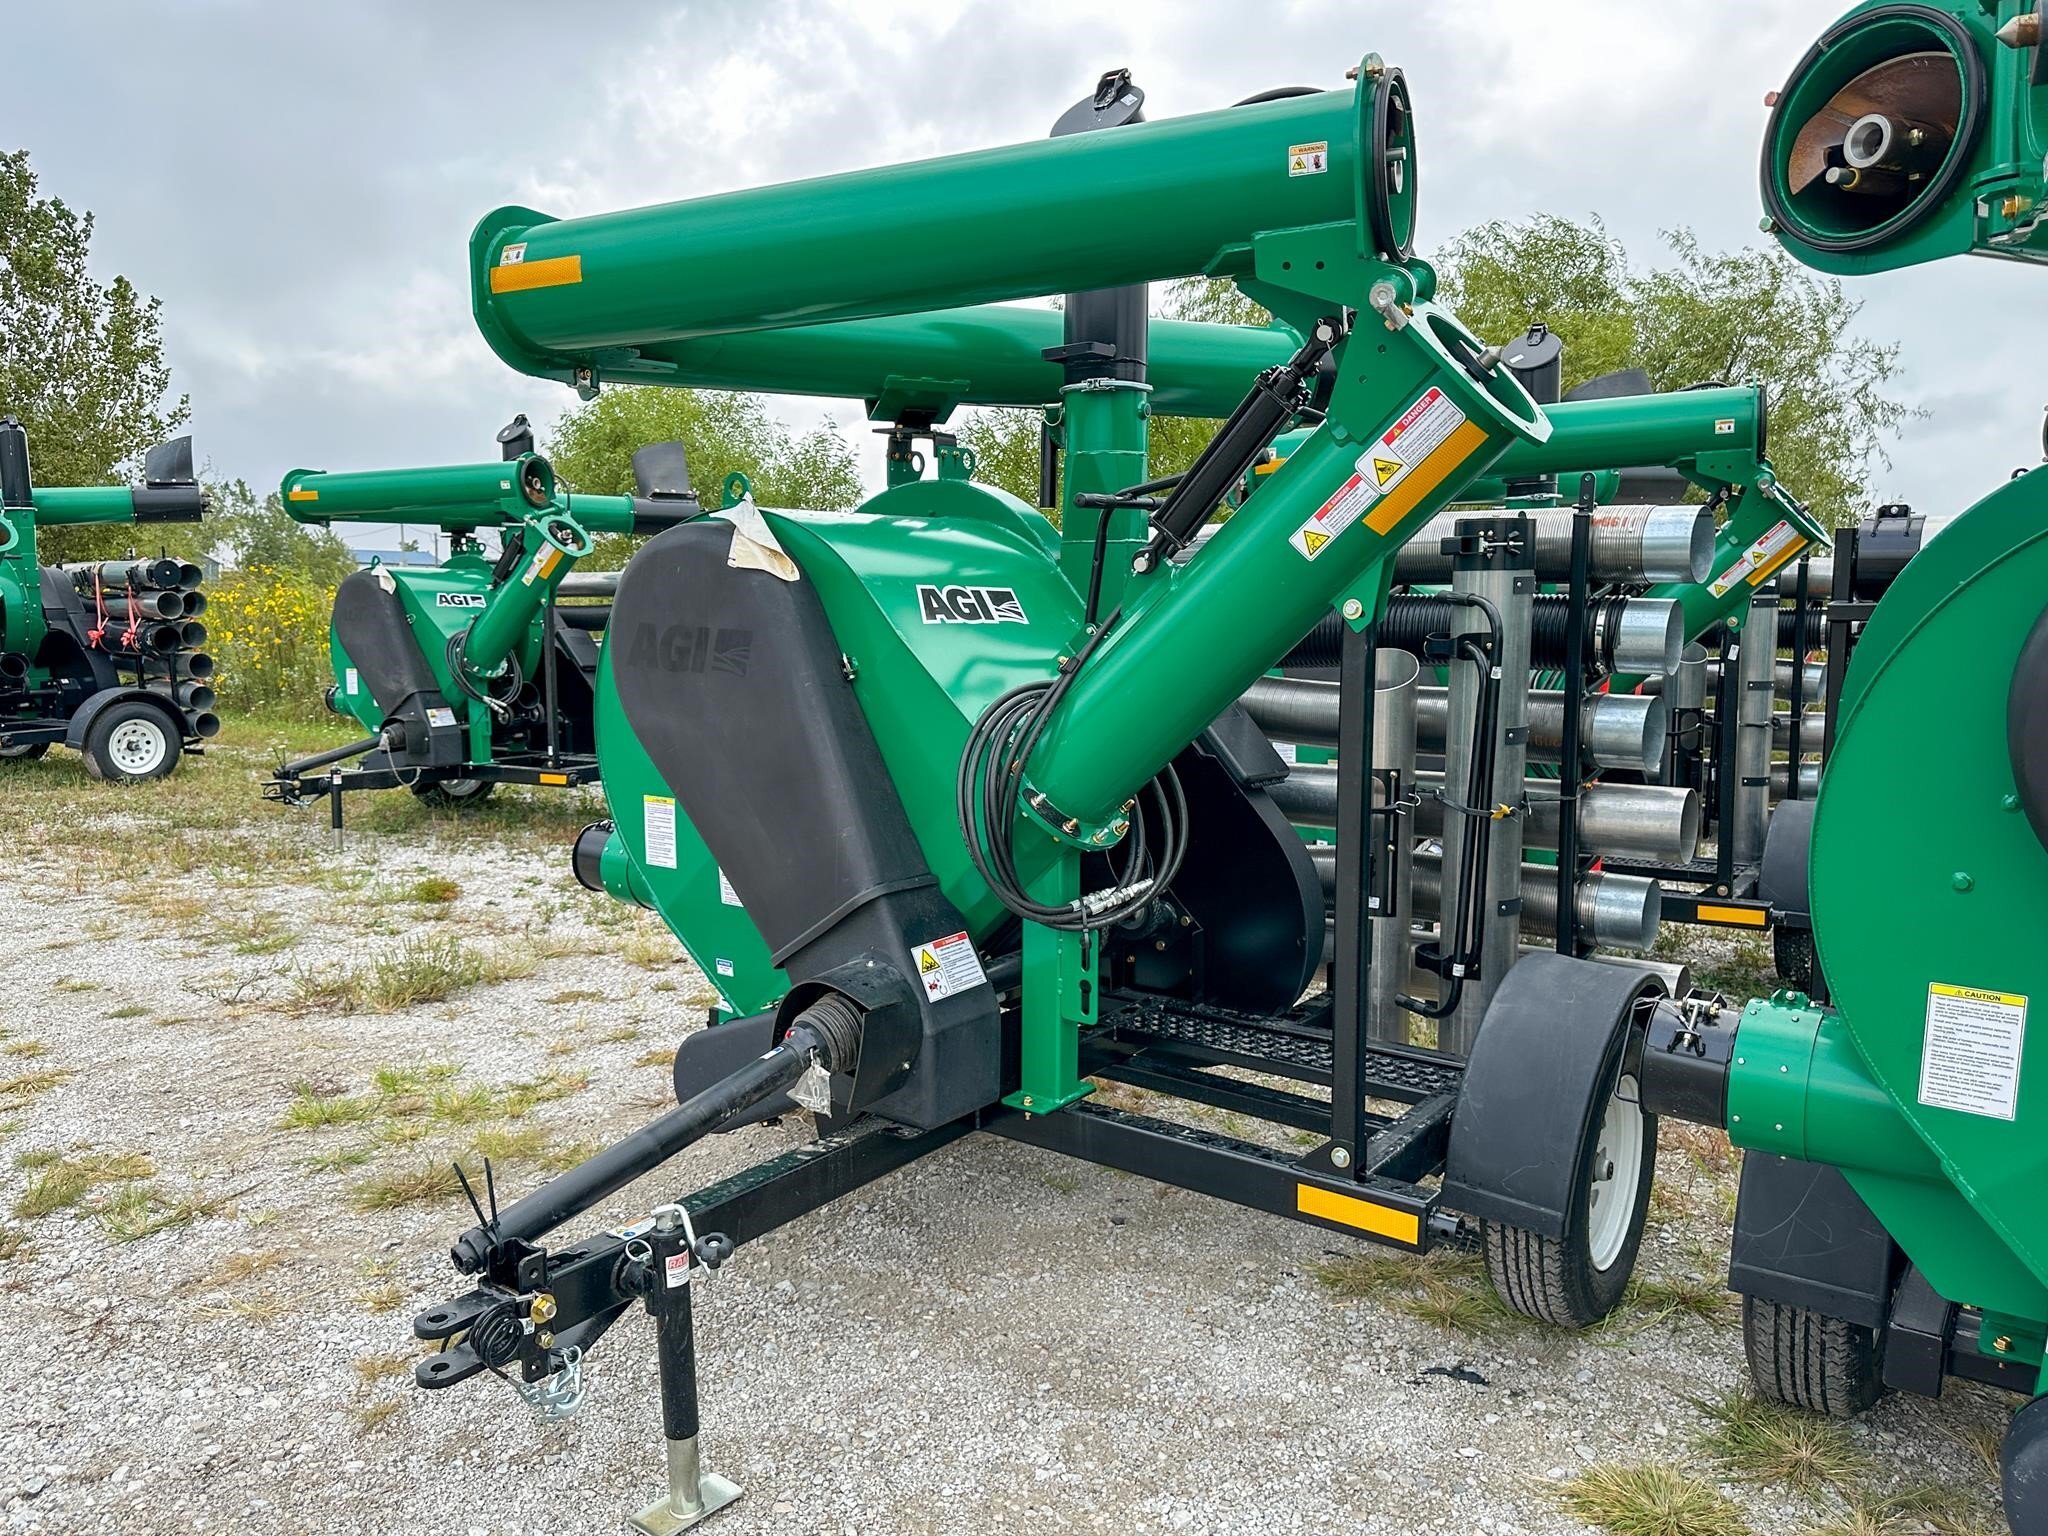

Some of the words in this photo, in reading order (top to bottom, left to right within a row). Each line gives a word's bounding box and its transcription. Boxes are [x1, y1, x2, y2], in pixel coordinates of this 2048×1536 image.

[1401, 396, 1432, 426] DANGER
[439, 594, 470, 606] AGI
[919, 588, 995, 621] AGI
[625, 622, 711, 674] AGI
[1964, 990, 2001, 1002] CAUTION
